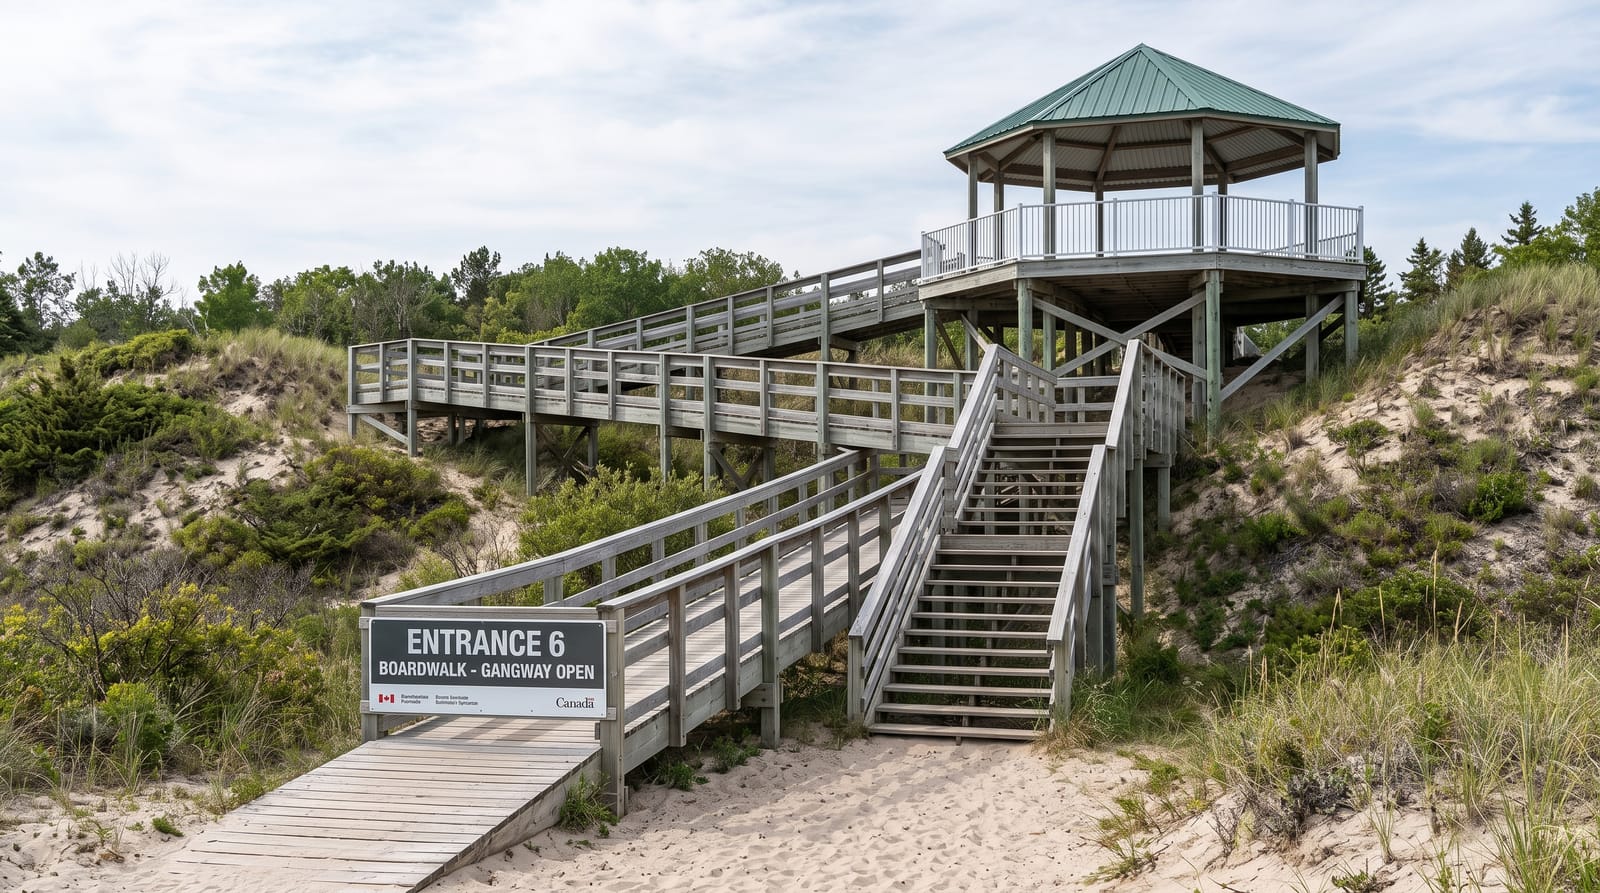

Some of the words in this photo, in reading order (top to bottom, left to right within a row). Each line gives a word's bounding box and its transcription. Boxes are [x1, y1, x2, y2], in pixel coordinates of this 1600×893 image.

[407, 628, 542, 657] ENTRANCE
[549, 630, 565, 657] 6
[379, 661, 467, 677] BOARDWALK
[481, 662, 552, 679] GANGWAY
[556, 664, 595, 680] OPEN
[556, 696, 594, 709] Canada
